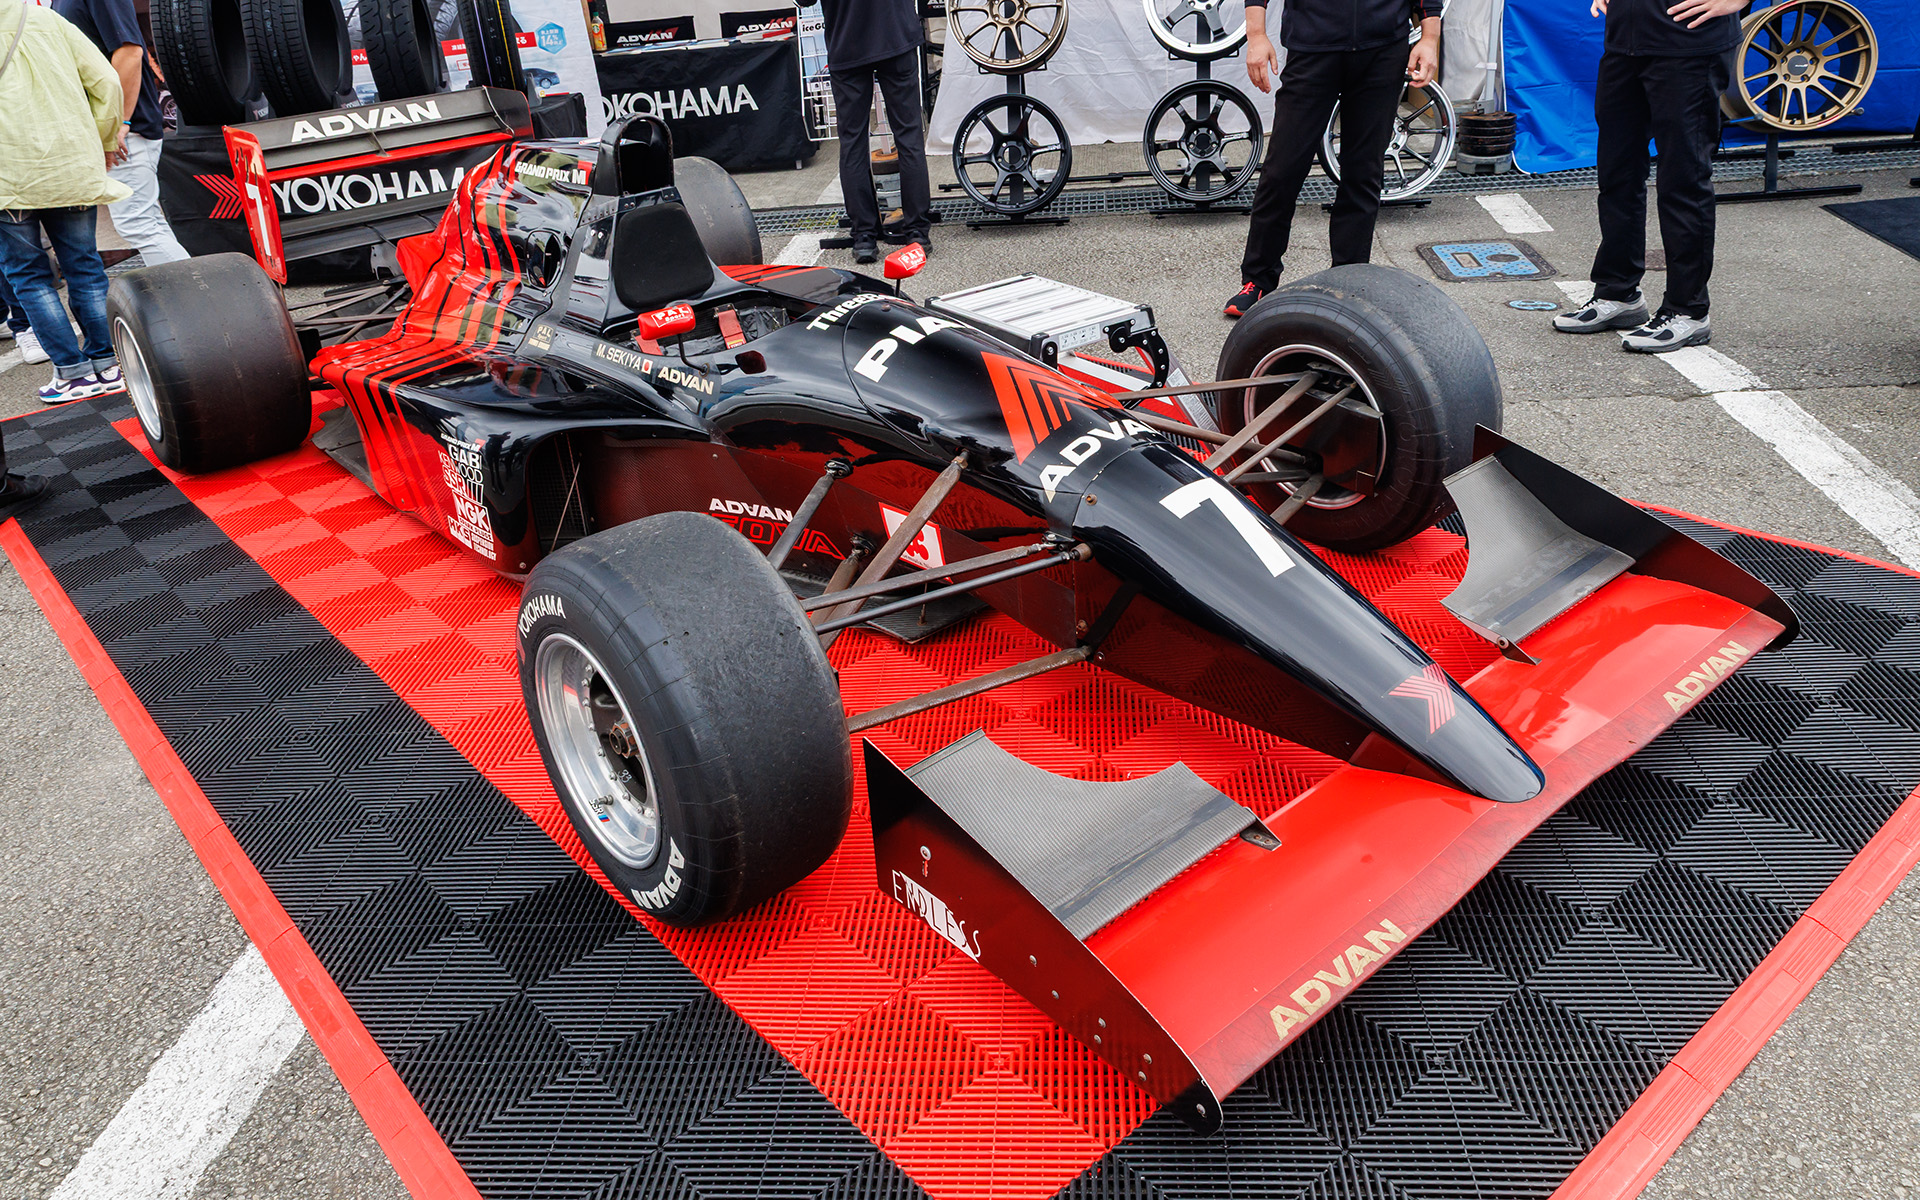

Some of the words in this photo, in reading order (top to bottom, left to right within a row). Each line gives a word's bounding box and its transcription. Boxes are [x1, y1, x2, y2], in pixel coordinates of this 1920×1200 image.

[616, 31, 673, 43] ADVAN
[736, 20, 793, 33] ADVAN
[291, 100, 442, 143] ADVAN
[271, 167, 465, 214] YOKOHAM
[514, 161, 546, 178] GRAND
[545, 167, 570, 183] PRIX
[572, 169, 586, 185] M
[901, 250, 924, 264] PAL
[537, 326, 551, 338] PAL
[596, 343, 606, 359] M.
[606, 347, 641, 372] SEKIYA
[657, 366, 715, 395] ADVAN
[453, 491, 490, 533] NGK
[709, 498, 794, 523] ADVAN
[1159, 477, 1296, 578] 7
[518, 595, 567, 639] YOKOHAMA
[1662, 640, 1751, 714] ADVAN
[631, 836, 685, 909] ADVAN
[892, 869, 981, 960] ENDLESS
[1269, 918, 1408, 1041] ADVAN
